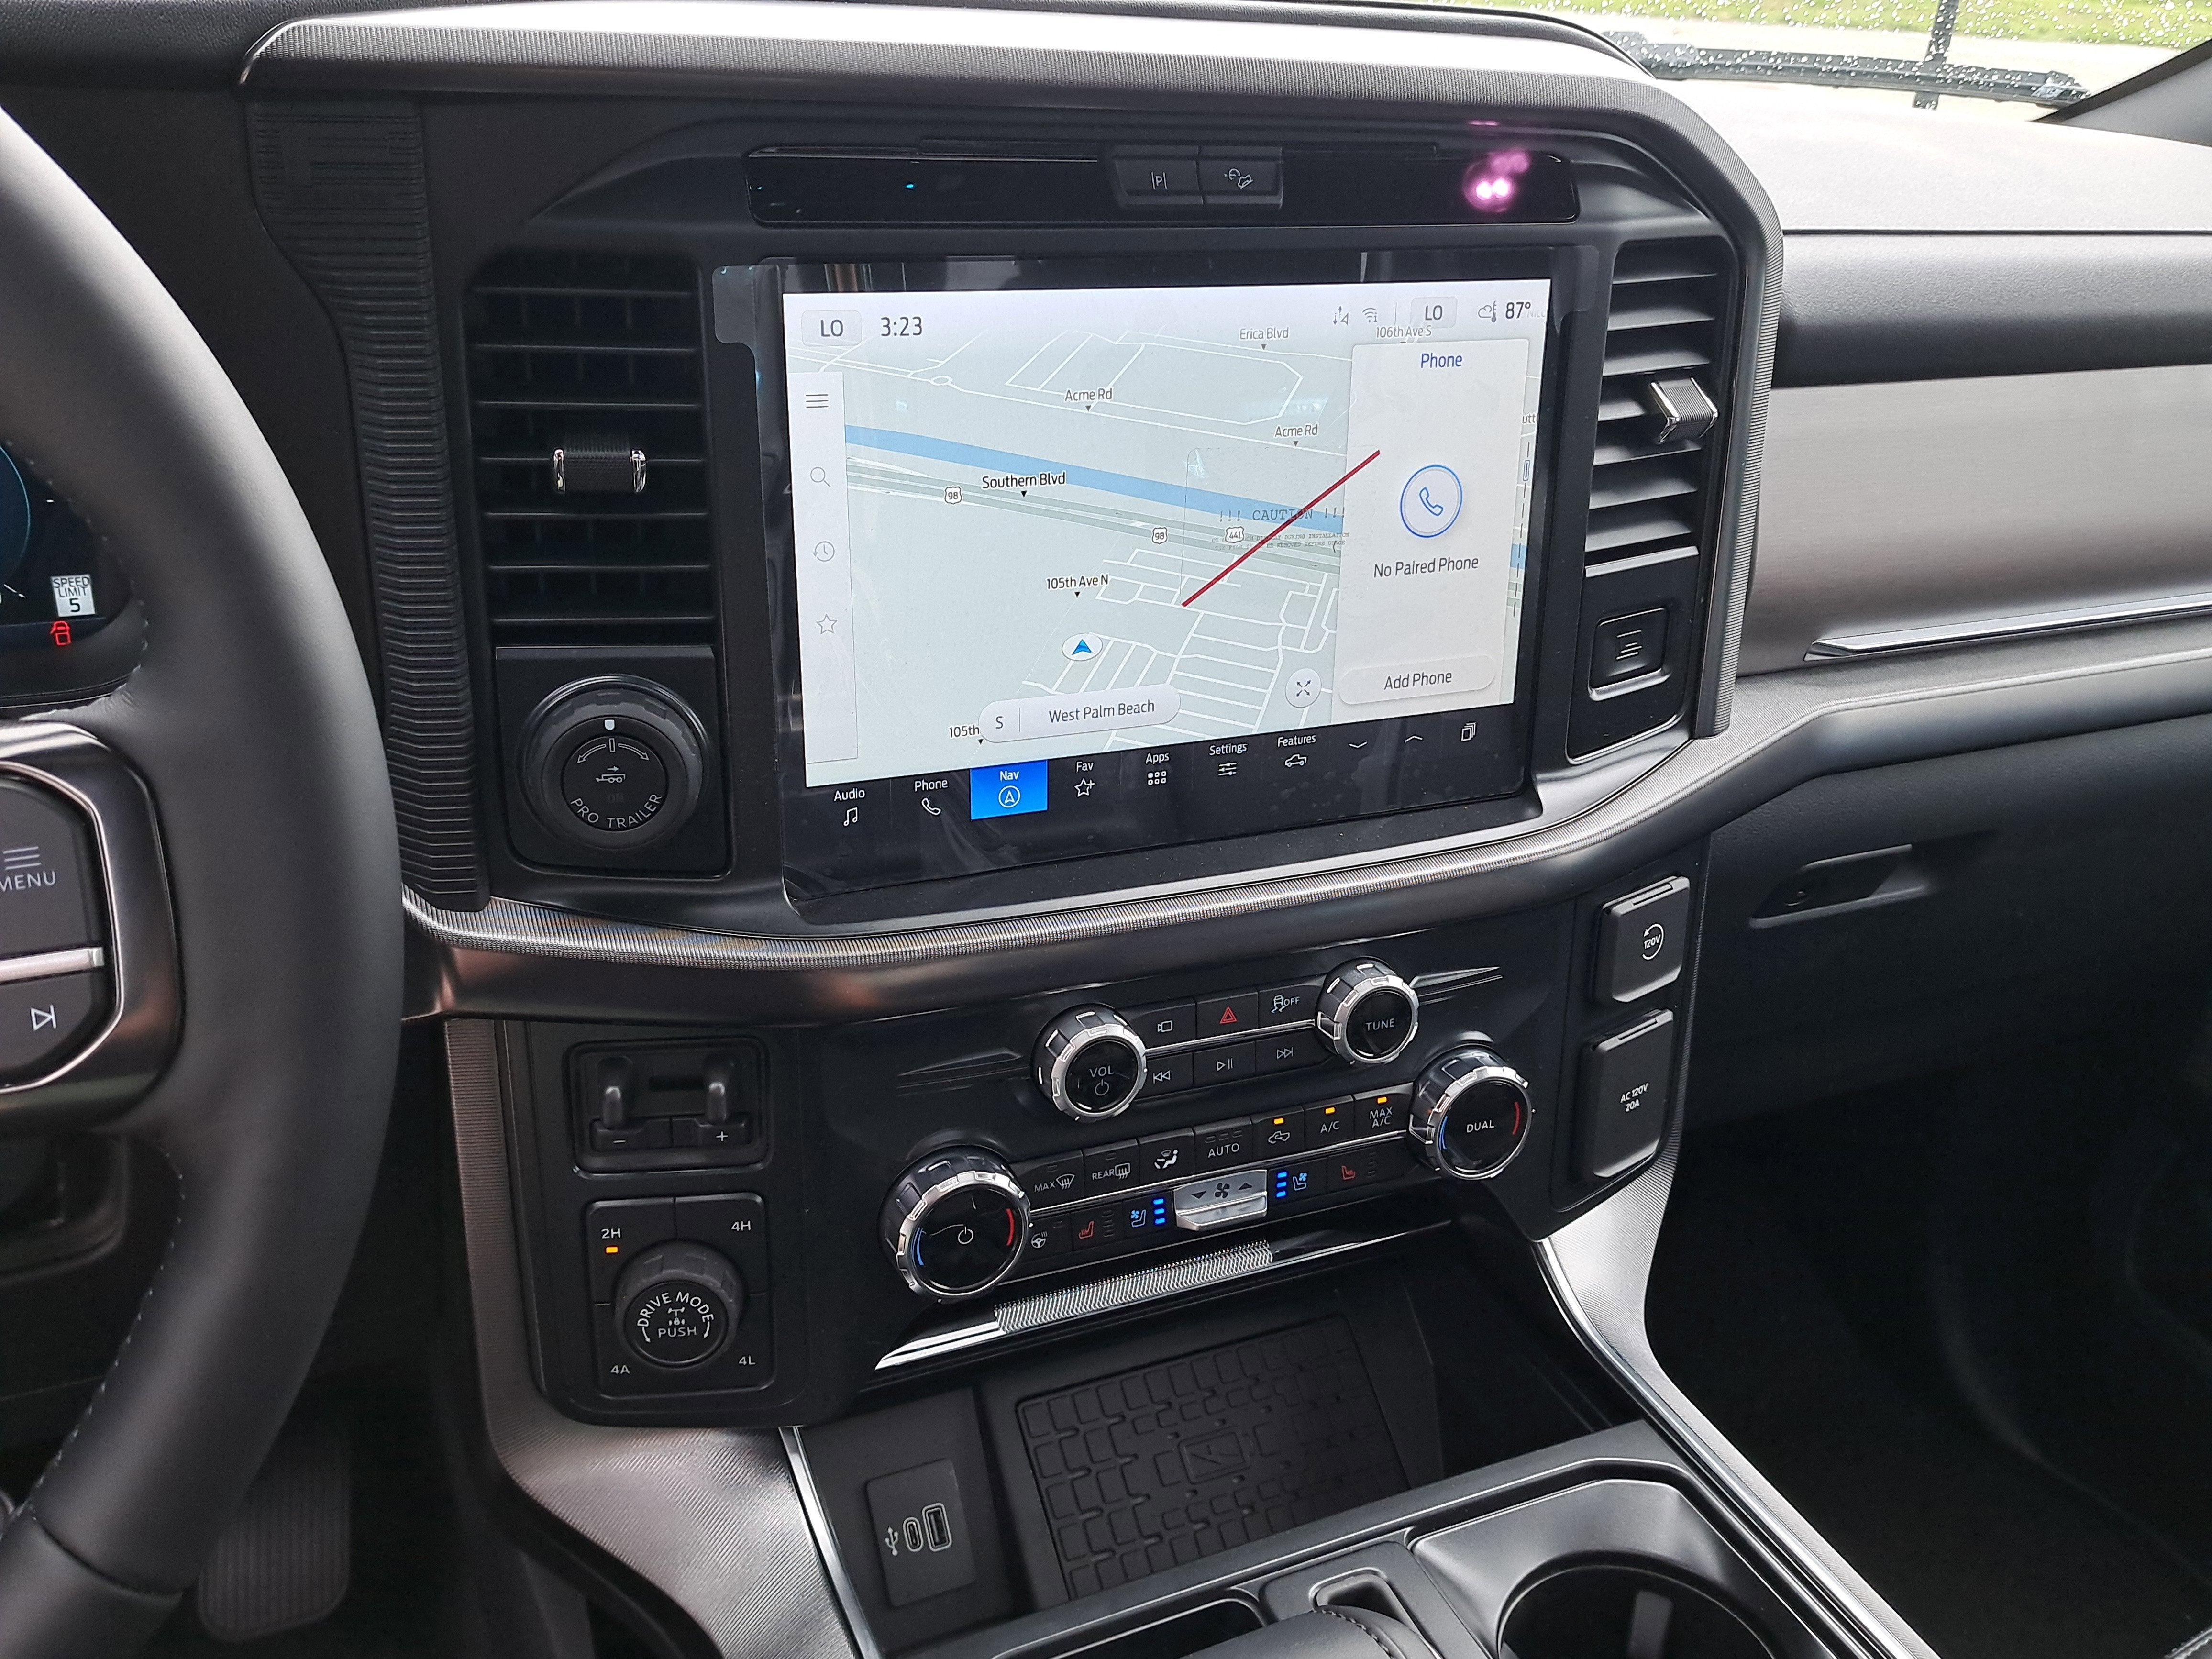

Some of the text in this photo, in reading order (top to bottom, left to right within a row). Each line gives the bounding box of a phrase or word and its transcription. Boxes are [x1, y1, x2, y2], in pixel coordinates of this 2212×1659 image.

[1425, 306, 1442, 321] LO
[820, 320, 844, 337] LO
[881, 317, 923, 336] 3:23
[1376, 326, 1432, 338] 106th Ave S
[1240, 327, 1289, 340] Erica Blvd
[1420, 353, 1462, 368] Phone
[1065, 388, 1113, 402] Acme Rd
[1274, 424, 1318, 438] Acme Rd
[982, 472, 1066, 488] Southern Blvd
[948, 491, 959, 500] 98
[1252, 509, 1313, 520] CAUTION
[1374, 556, 1479, 578] No Paired Phone
[53, 576, 90, 588] SPEED
[1047, 574, 1108, 589] 105th Ave N
[58, 586, 87, 597] LIMIT
[69, 597, 81, 612] 5
[1384, 672, 1452, 690] Add Phone
[1049, 700, 1155, 723] West Palm Beach
[995, 716, 1004, 729] S
[949, 725, 980, 738] 105th
[1277, 734, 1316, 747] Features
[1209, 741, 1248, 757] Settings
[1146, 752, 1169, 764] Apps
[1076, 761, 1094, 772] Fav
[999, 770, 1019, 781] Nav
[914, 777, 948, 792] Phone
[834, 788, 865, 802] Audio
[570, 793, 663, 829] PRO TRAILER
[0, 871, 56, 892] MENU
[1644, 934, 1661, 949] 120V
[1283, 996, 1301, 1006] OFF
[1365, 1018, 1395, 1032] TUNE
[1089, 1066, 1114, 1078] VOL
[1620, 1082, 1648, 1104] AC 120V
[1626, 1099, 1640, 1112] 20A
[1370, 1106, 1393, 1120] MAX
[1320, 1120, 1339, 1133] A/C
[1371, 1115, 1391, 1129] A/C
[1466, 1120, 1495, 1133] DUAL
[1208, 1143, 1240, 1158] AUTO
[1092, 1169, 1114, 1181] REAR
[1034, 1181, 1056, 1193] MAX
[731, 1220, 752, 1232] 4H
[601, 1228, 621, 1239] 2H
[637, 1291, 714, 1327] DRIVE MODE
[658, 1326, 697, 1338] PUSH
[739, 1356, 755, 1366] 4L
[610, 1364, 630, 1375] 4A
